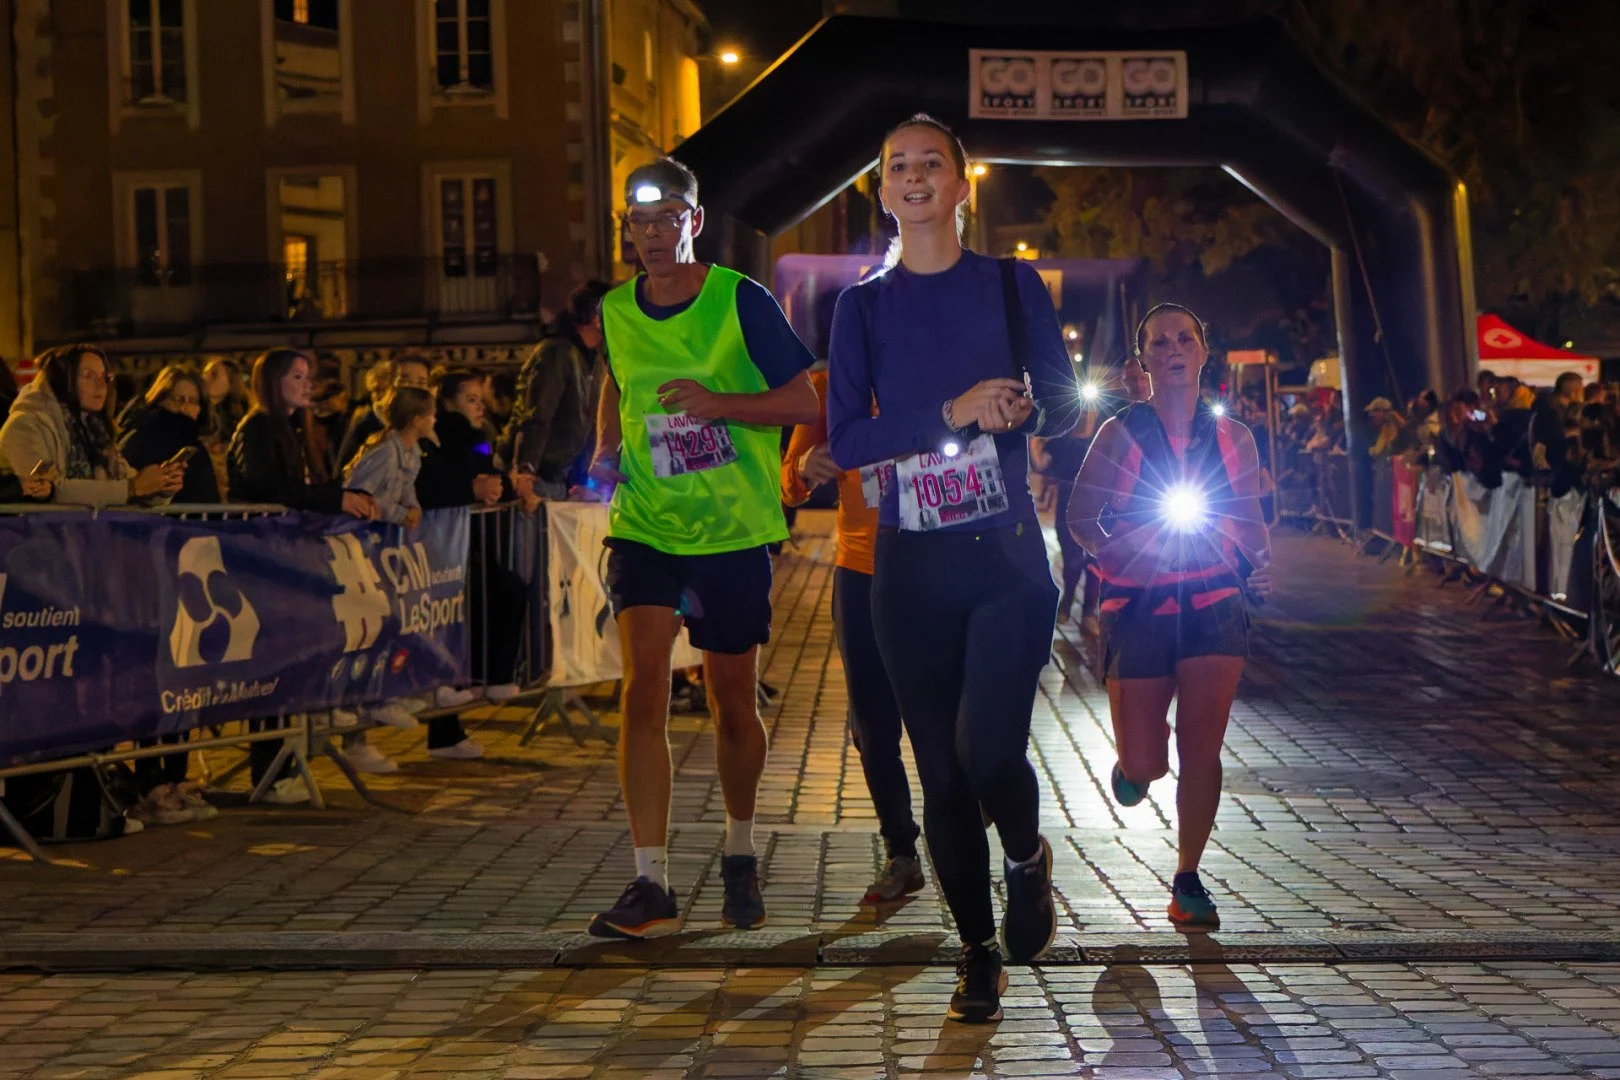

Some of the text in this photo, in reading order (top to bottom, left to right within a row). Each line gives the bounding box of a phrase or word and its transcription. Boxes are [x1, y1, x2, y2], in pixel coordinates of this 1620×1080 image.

[663, 425, 718, 459] 1429
[911, 464, 982, 510] 1054
[2, 605, 80, 629] soutient
[399, 590, 465, 638] LeSport
